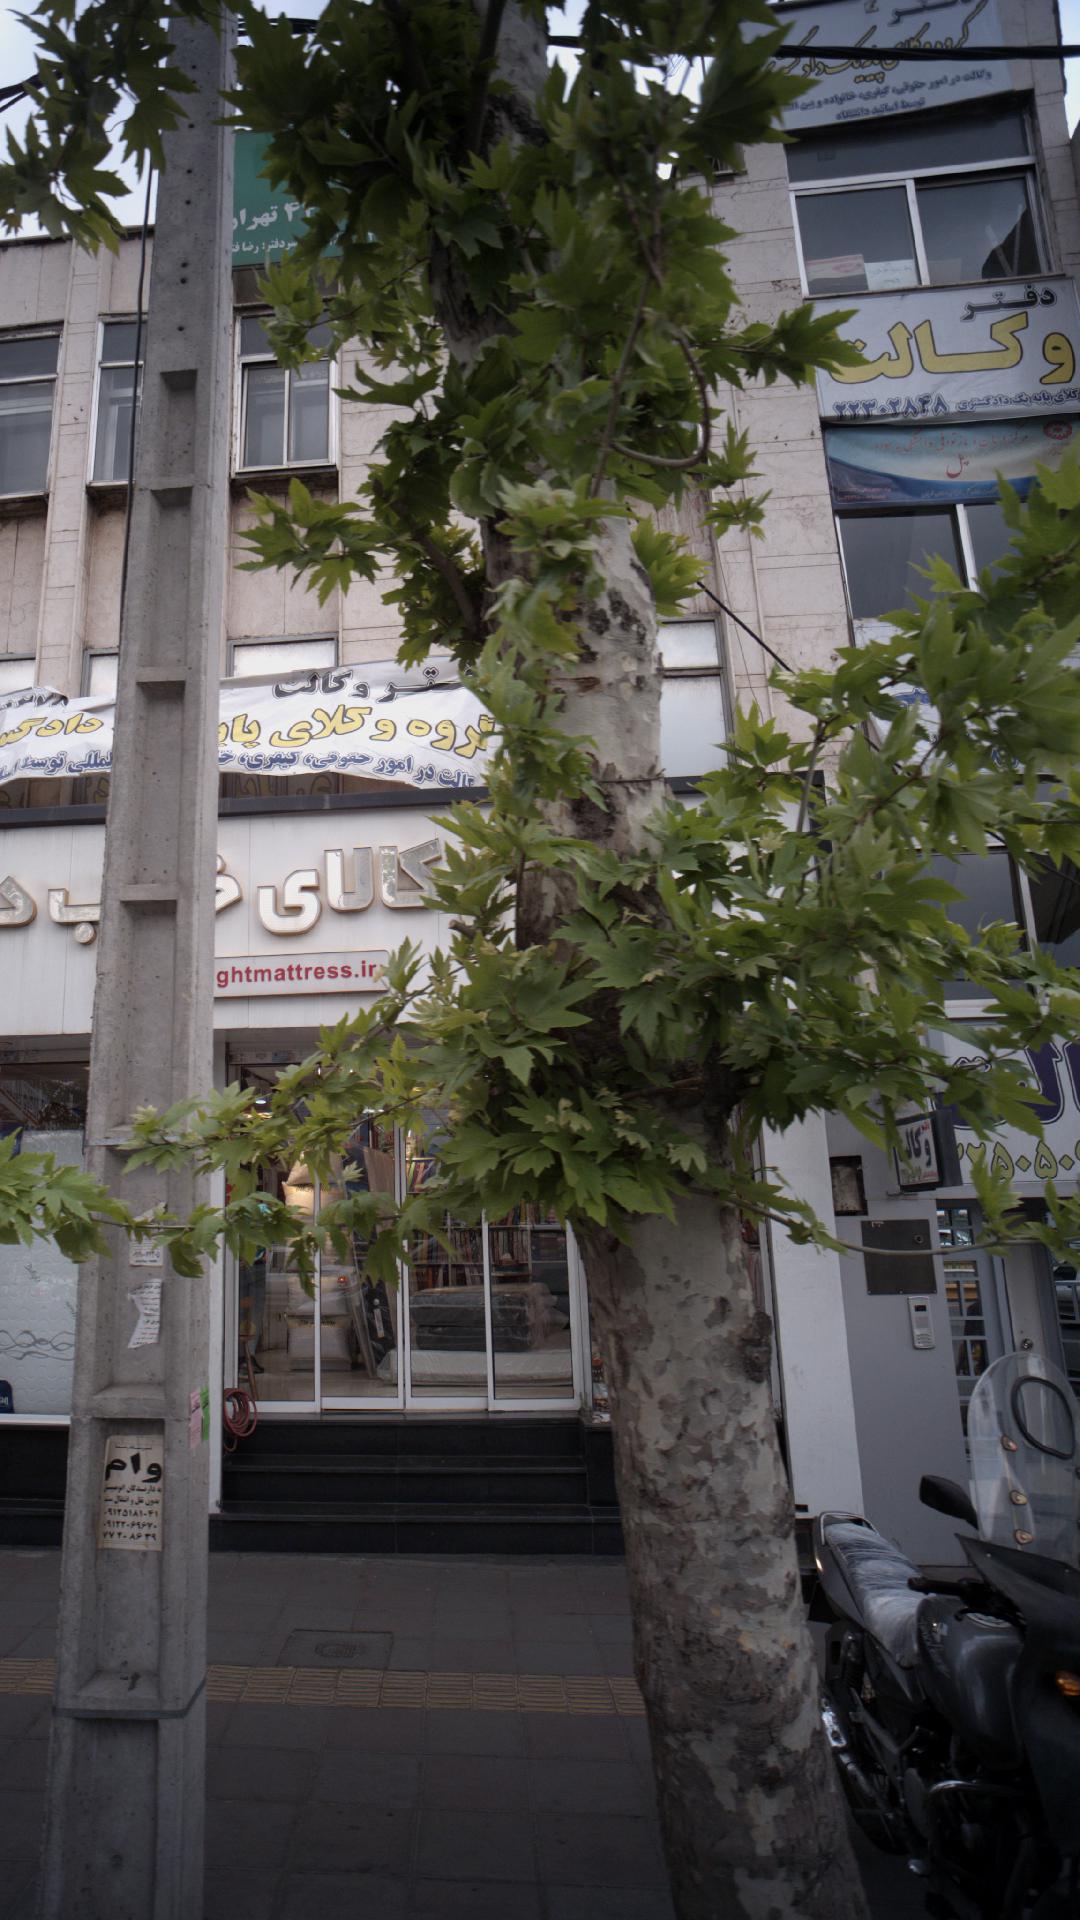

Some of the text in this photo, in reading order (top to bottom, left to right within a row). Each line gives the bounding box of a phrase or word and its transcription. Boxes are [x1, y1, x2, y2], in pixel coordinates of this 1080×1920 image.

[959, 283, 1056, 323] دفتر
[829, 311, 1075, 385] وکالت
[1053, 387, 1080, 405] کلای
[218, 713, 261, 749] پای
[269, 704, 397, 748] وکلای
[373, 755, 414, 776] امور
[414, 764, 436, 784] در
[105, 1452, 162, 1483] وام
